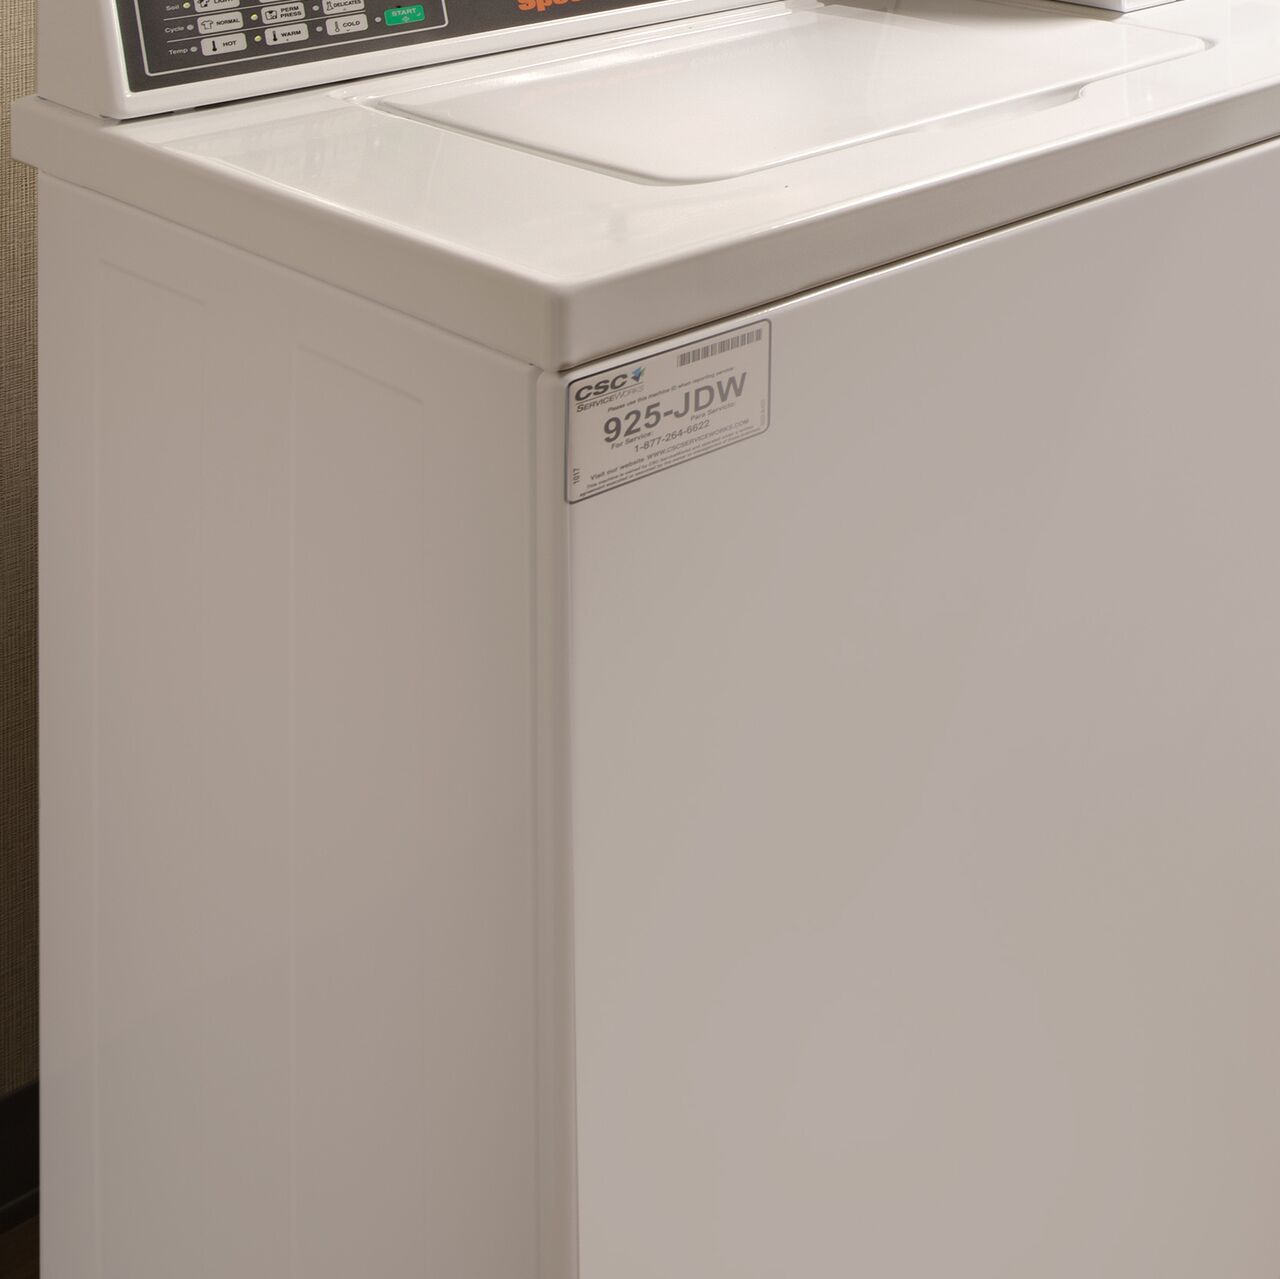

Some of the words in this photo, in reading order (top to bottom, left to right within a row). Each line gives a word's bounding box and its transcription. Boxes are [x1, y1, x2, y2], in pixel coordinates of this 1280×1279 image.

[333, 0, 362, 8] DELICATES
[280, 6, 300, 14] PERM
[391, 8, 417, 17] START
[280, 11, 302, 19] PRESS
[216, 18, 241, 26] NORMAL
[342, 20, 361, 28] COLD
[164, 25, 185, 34] Cycle
[280, 29, 302, 38] WARM
[168, 48, 188, 56] Temp
[575, 373, 628, 402] CSC
[604, 371, 747, 443] 925-JDW
[634, 418, 709, 453] 1-877-264-6622
[590, 470, 605, 481] Visit
